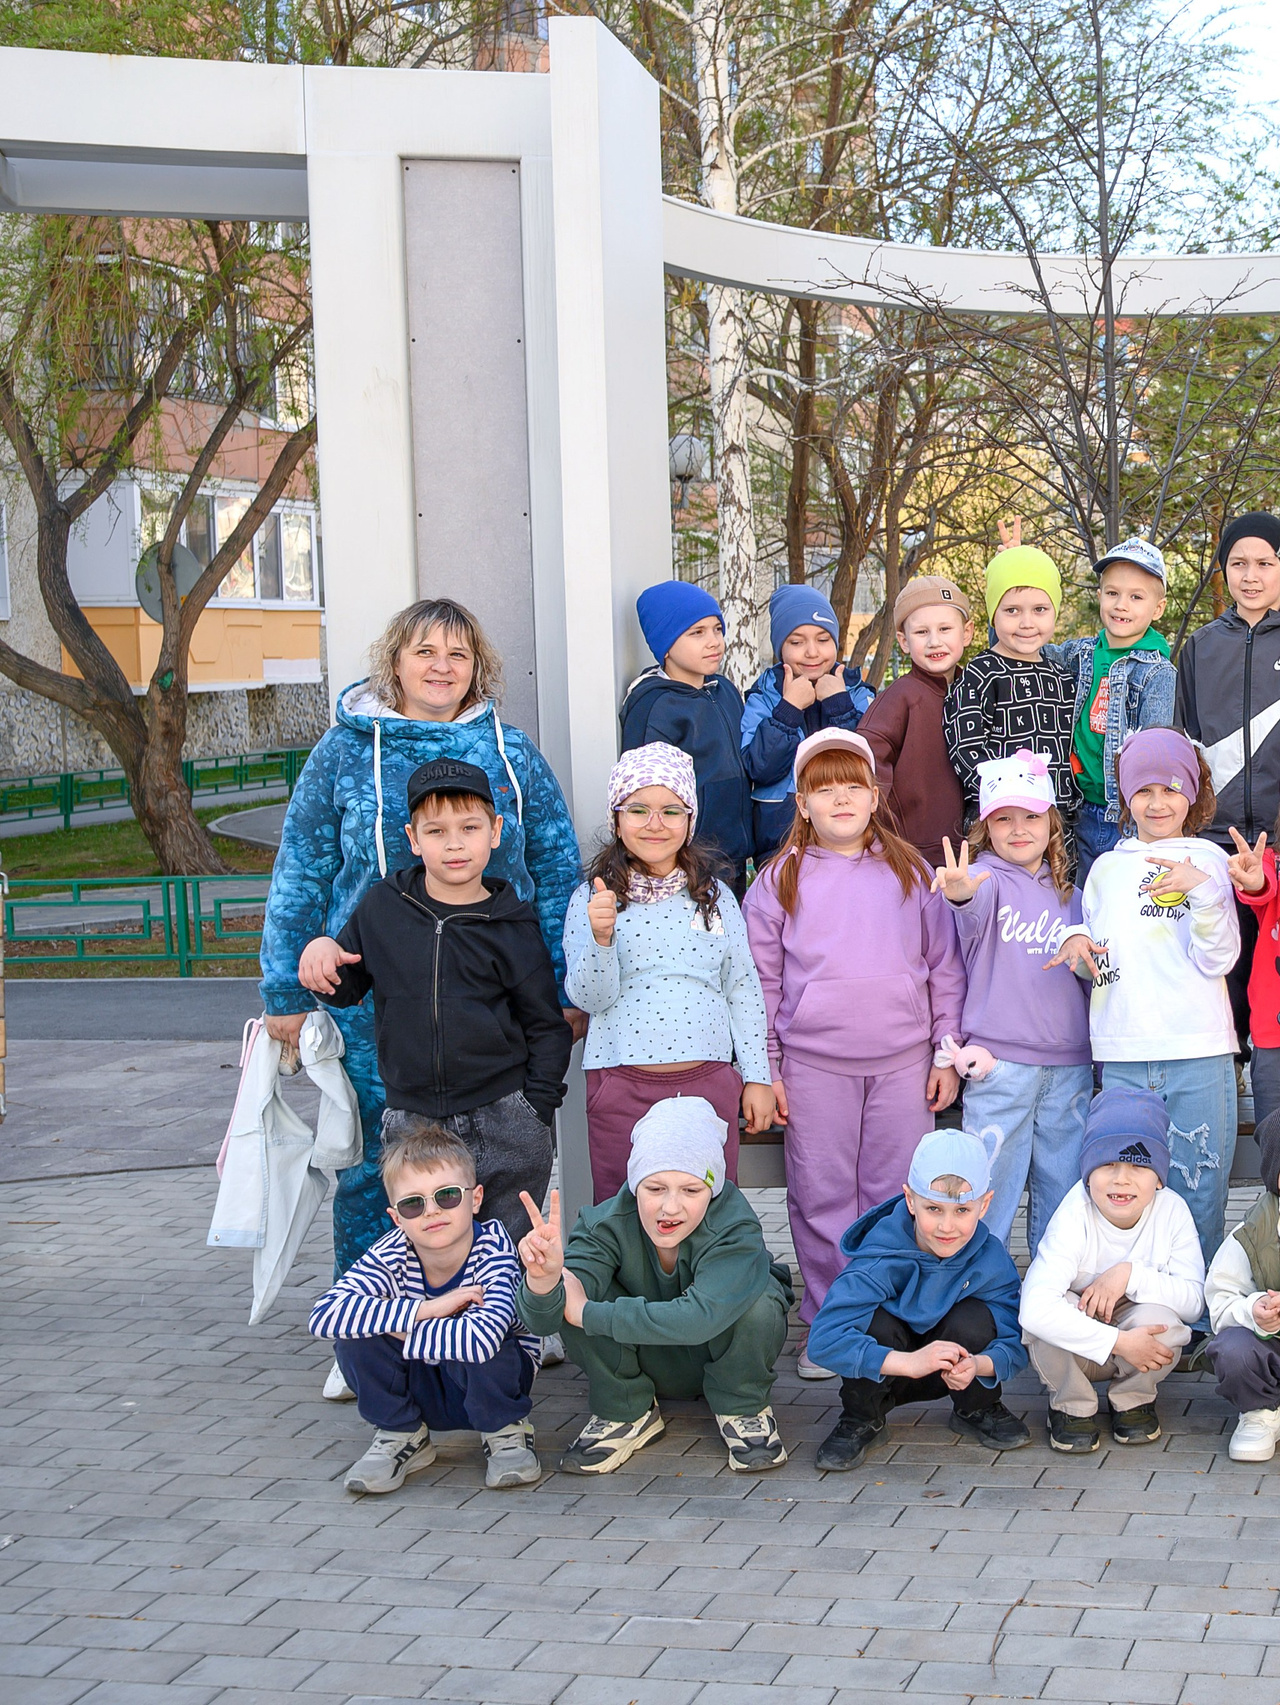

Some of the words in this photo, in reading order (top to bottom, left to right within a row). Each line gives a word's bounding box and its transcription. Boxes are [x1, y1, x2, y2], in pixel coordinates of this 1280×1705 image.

[419, 763, 473, 784] SKATERS
[1140, 904, 1164, 917] GOOD
[997, 905, 1067, 953] Vulp
[1119, 1153, 1152, 1164] adidas
